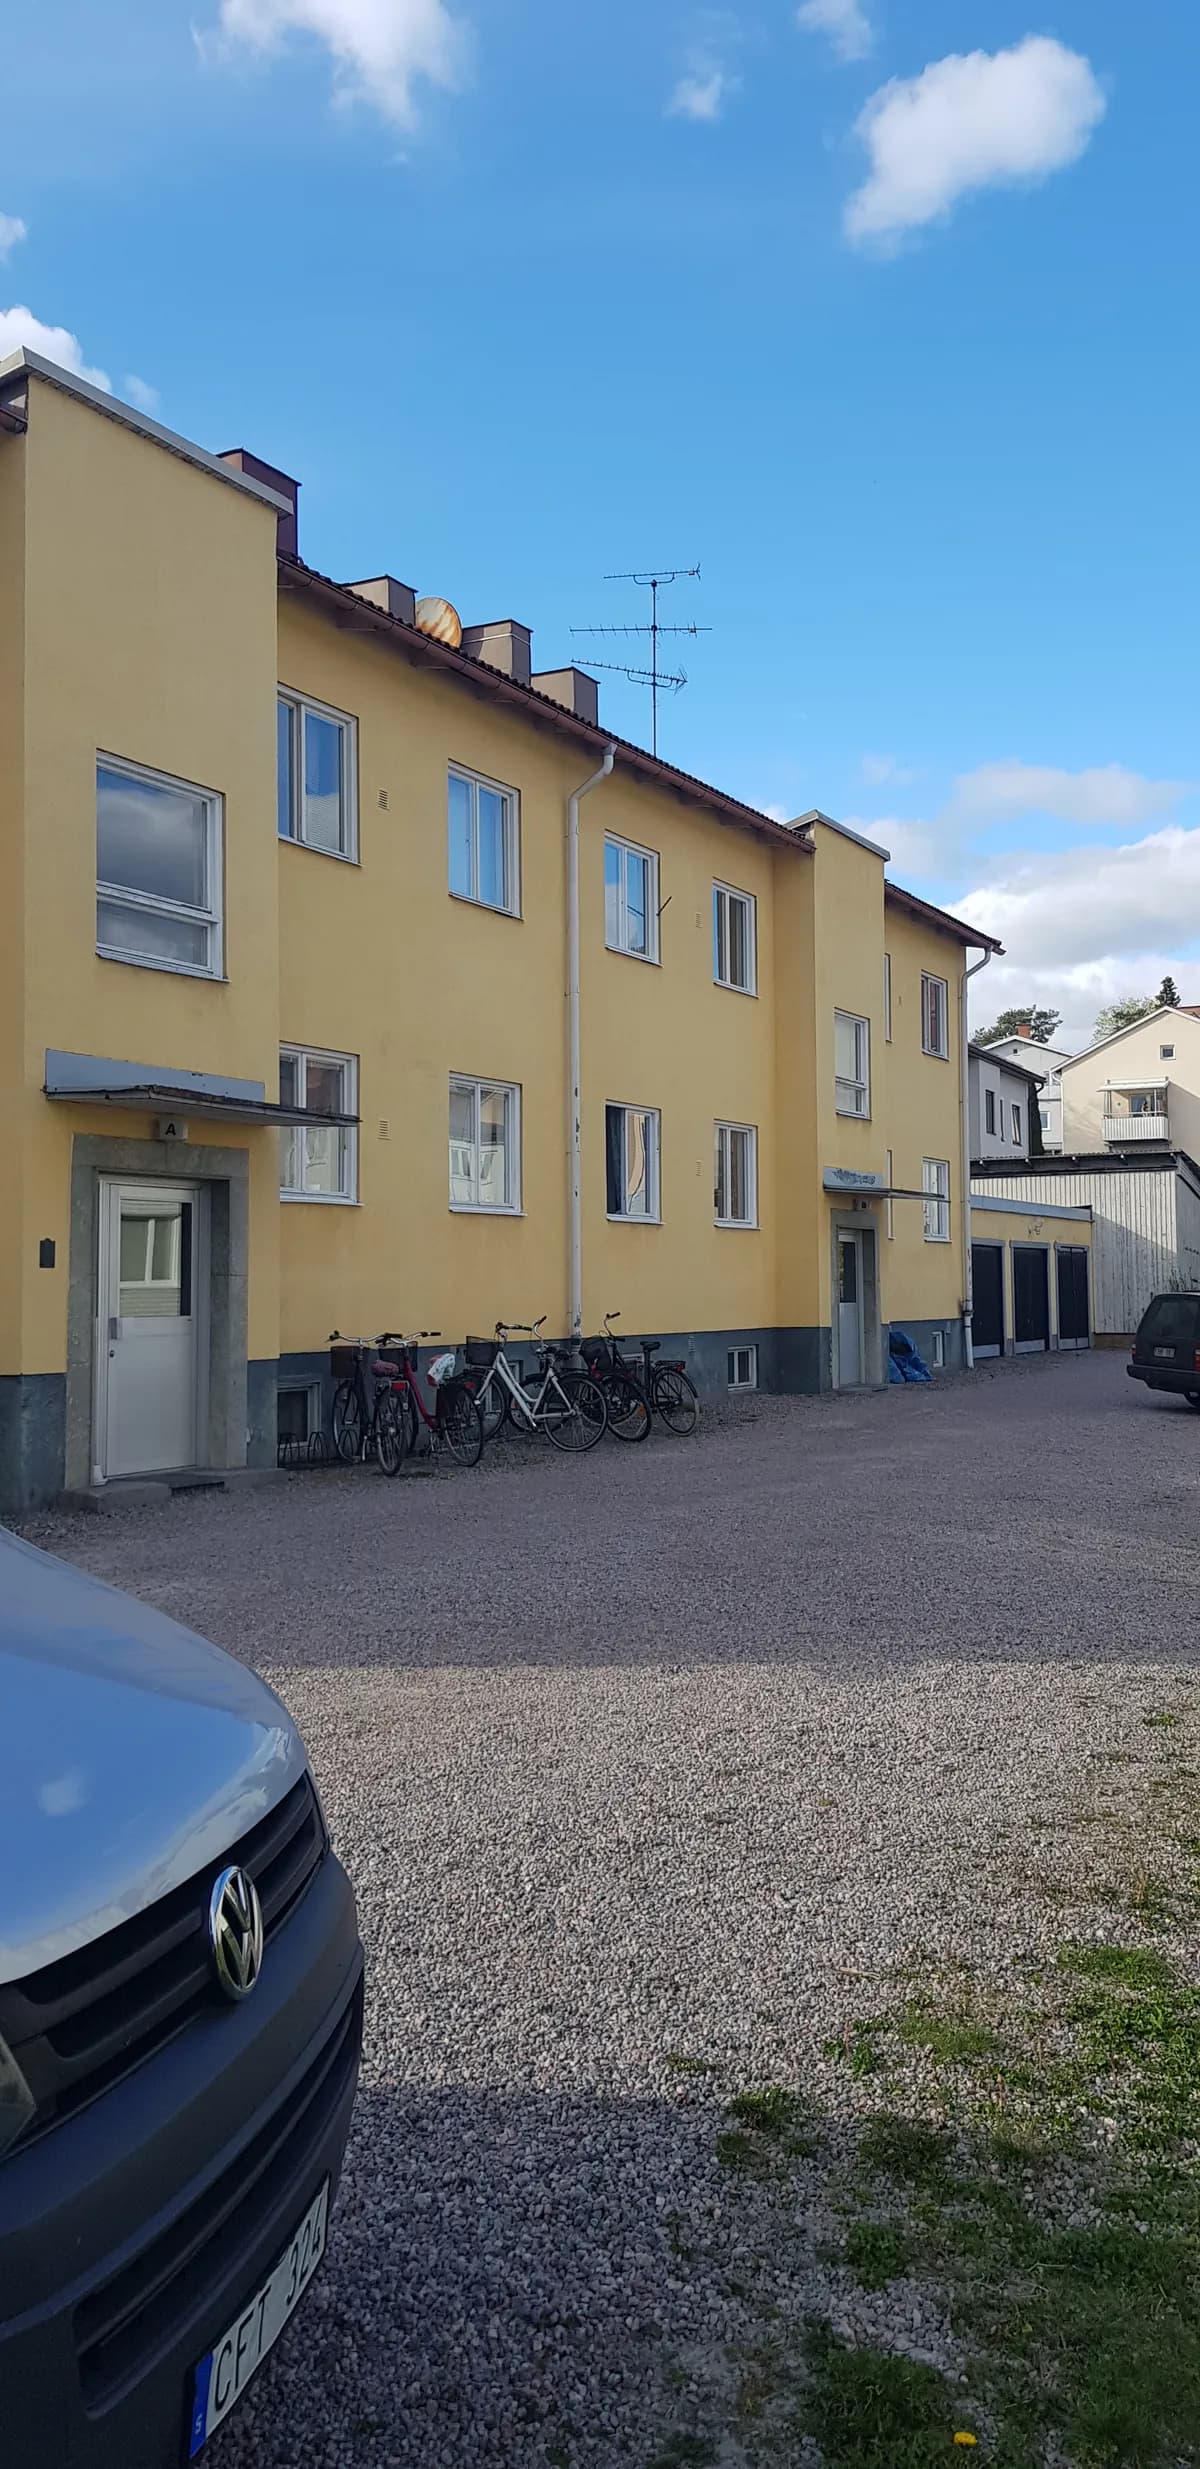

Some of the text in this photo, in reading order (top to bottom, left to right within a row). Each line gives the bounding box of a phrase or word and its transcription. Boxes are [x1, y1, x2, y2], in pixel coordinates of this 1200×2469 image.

[165, 1123, 176, 1136] A
[212, 1867, 263, 1992] VW
[214, 2198, 321, 2413] CFT 324
[194, 2413, 203, 2435] S
